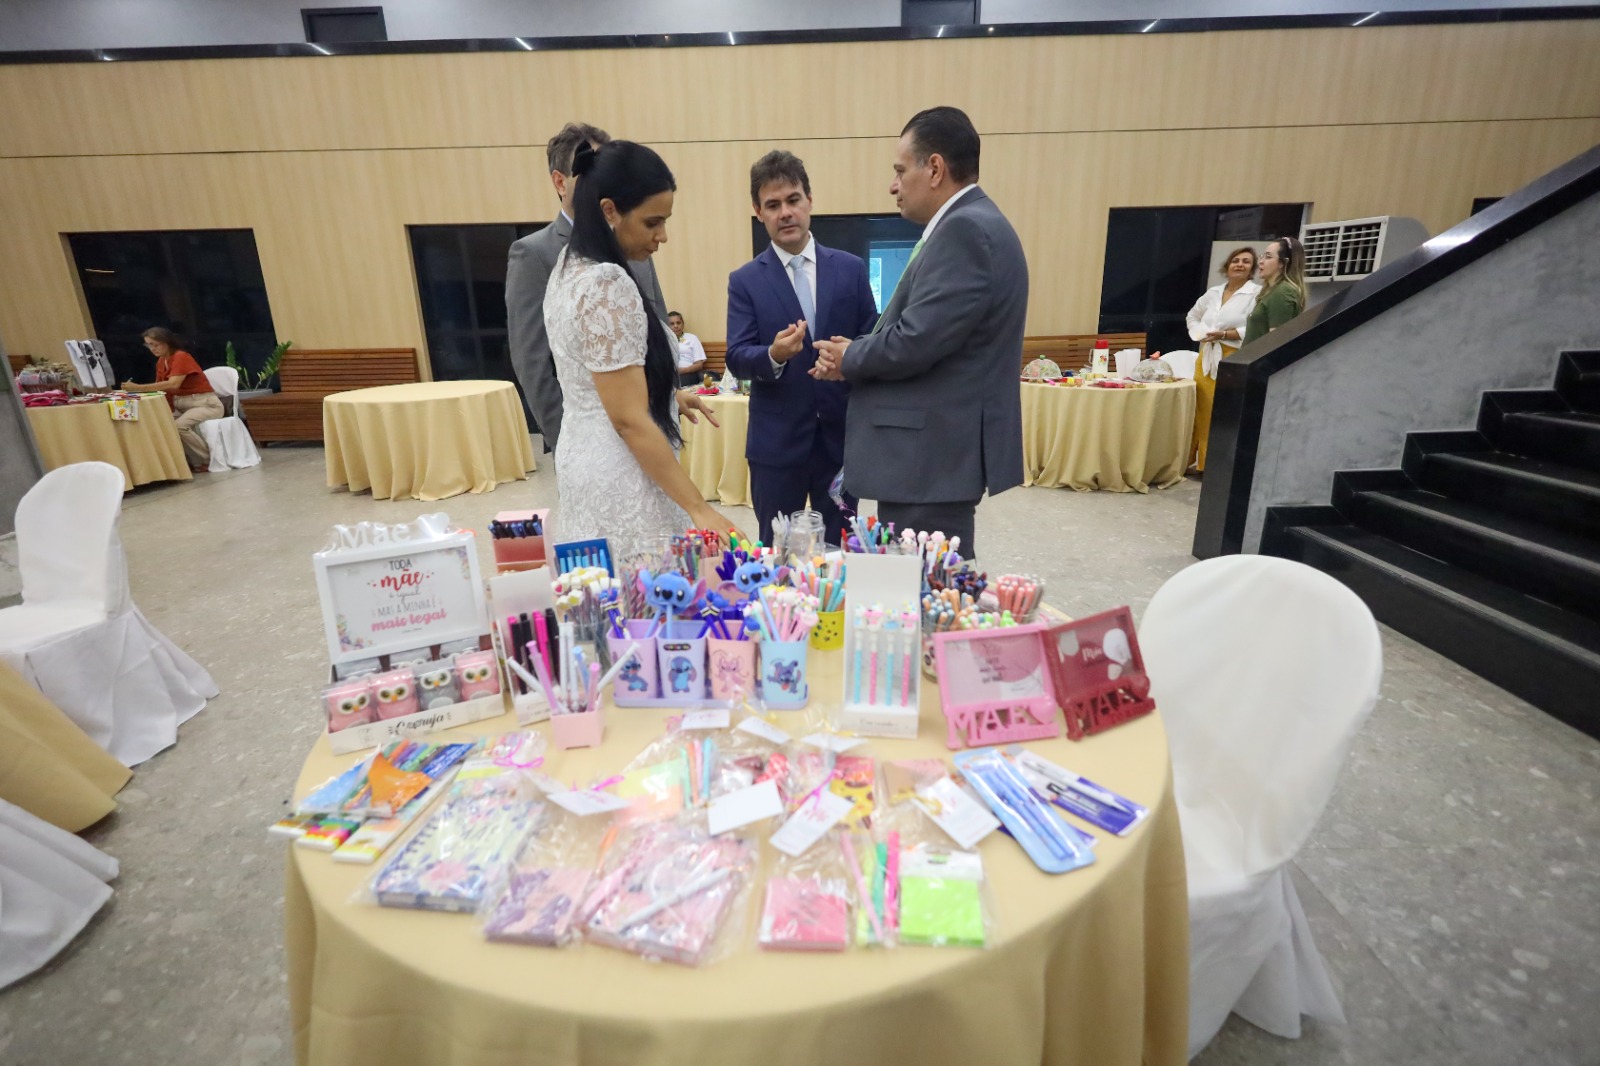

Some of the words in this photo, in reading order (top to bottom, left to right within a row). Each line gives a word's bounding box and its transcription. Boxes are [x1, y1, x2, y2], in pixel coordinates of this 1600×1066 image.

[389, 558, 413, 571] TODA
[380, 568, 424, 592] mãe
[377, 605, 395, 617] MAS
[403, 599, 431, 613] MINHA
[371, 616, 408, 632] mais
[409, 608, 448, 625] legal
